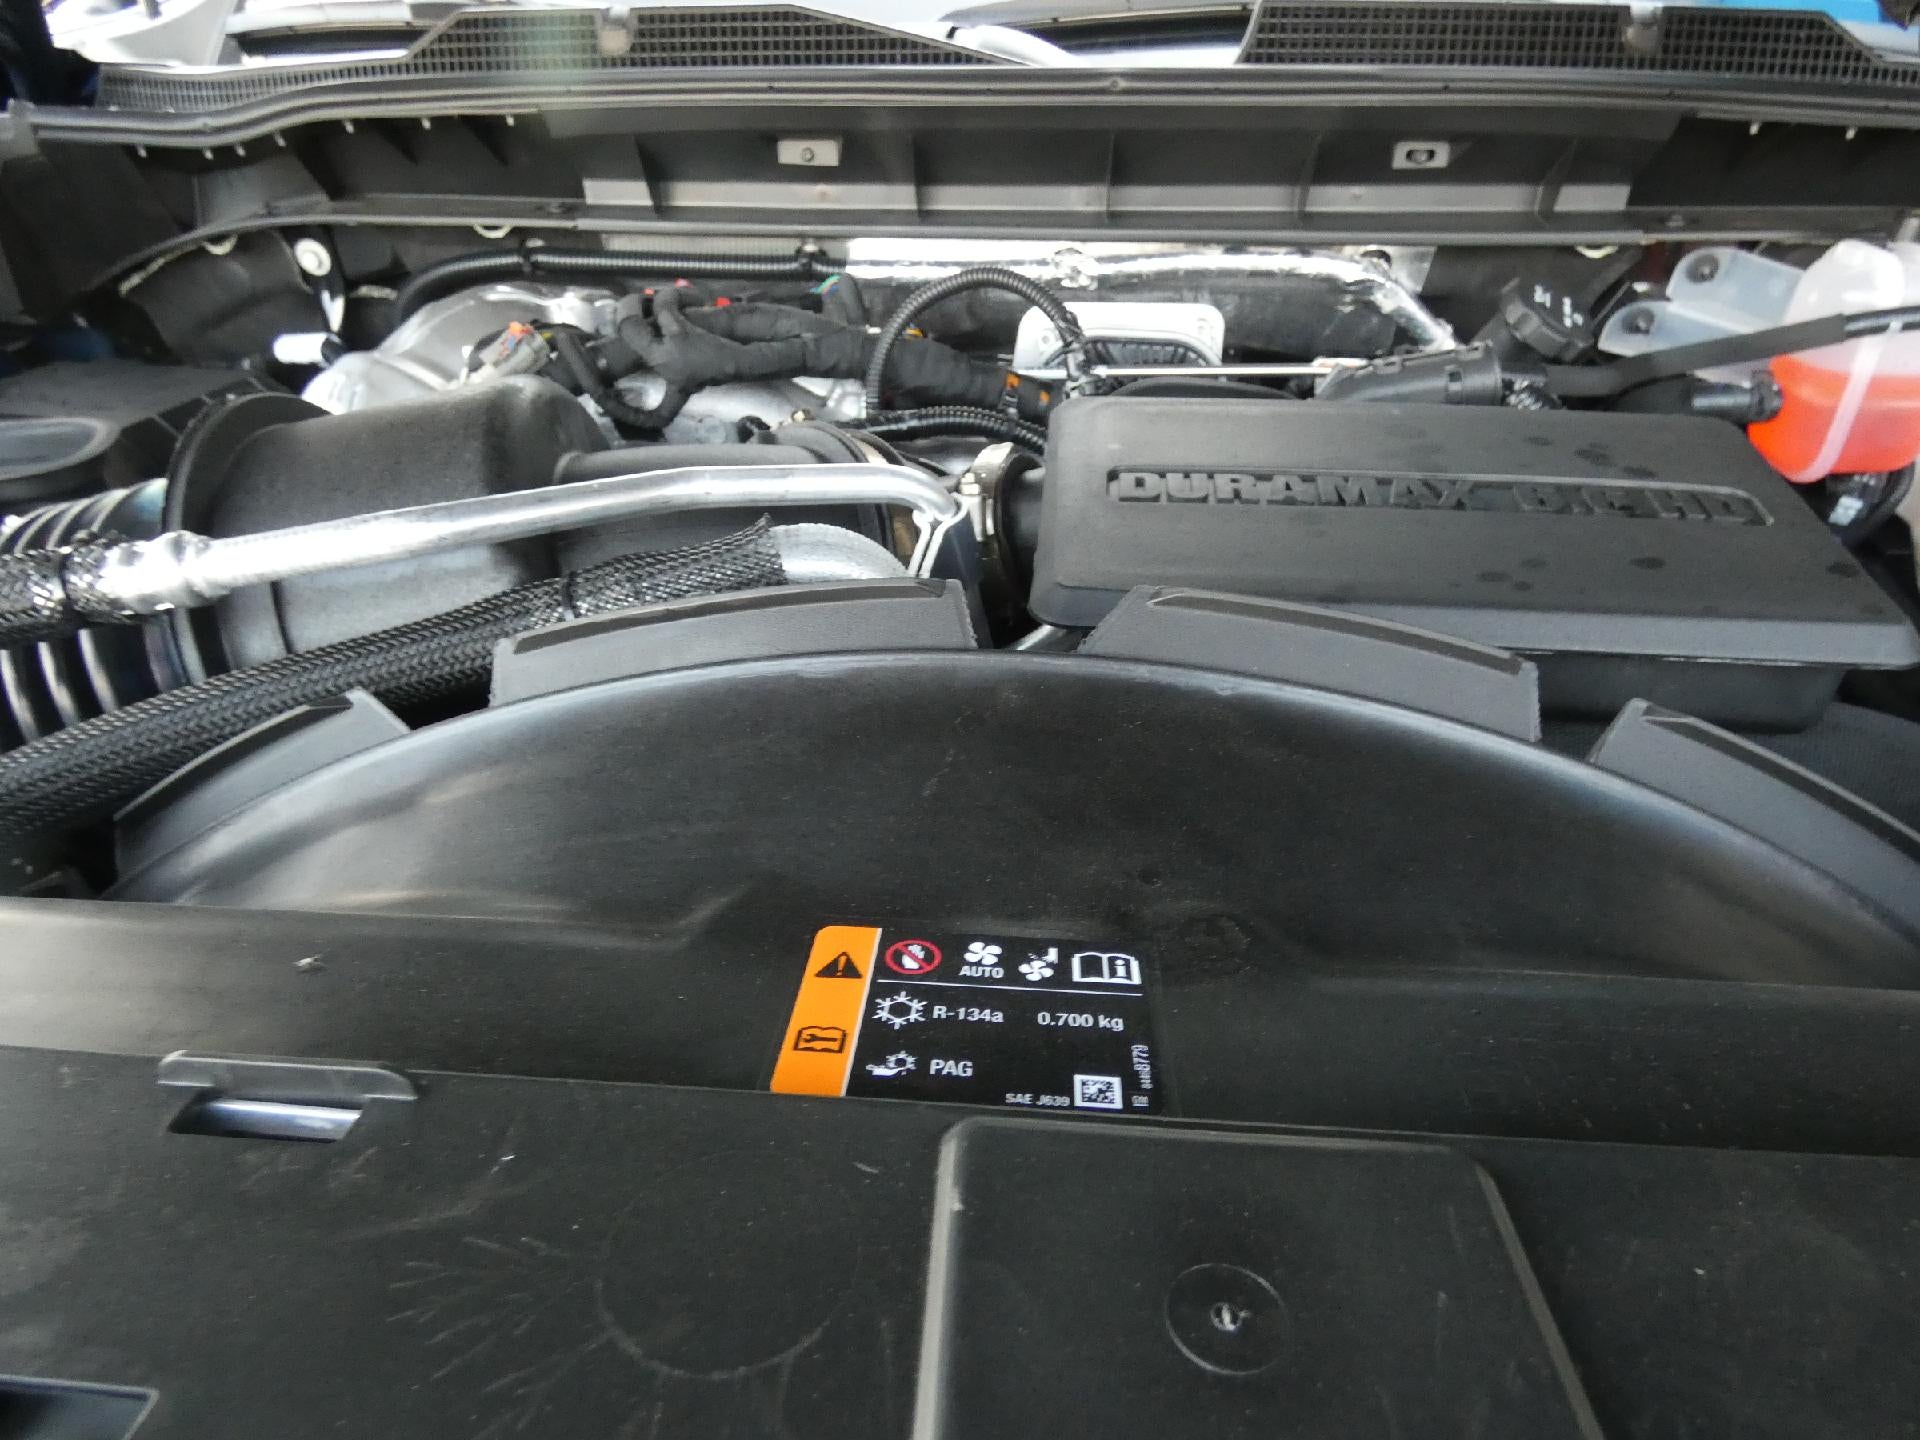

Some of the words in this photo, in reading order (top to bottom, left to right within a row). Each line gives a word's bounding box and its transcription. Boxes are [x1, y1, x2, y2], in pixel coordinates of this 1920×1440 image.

[1117, 471, 1472, 510] DURAMAX
[958, 965, 1005, 979] AUTO
[932, 1005, 1004, 1023] R-134a
[1037, 1011, 1094, 1028] 0.700
[1098, 1014, 1124, 1032] kg
[929, 1059, 974, 1077] PAG
[1005, 1093, 1034, 1104] SAE
